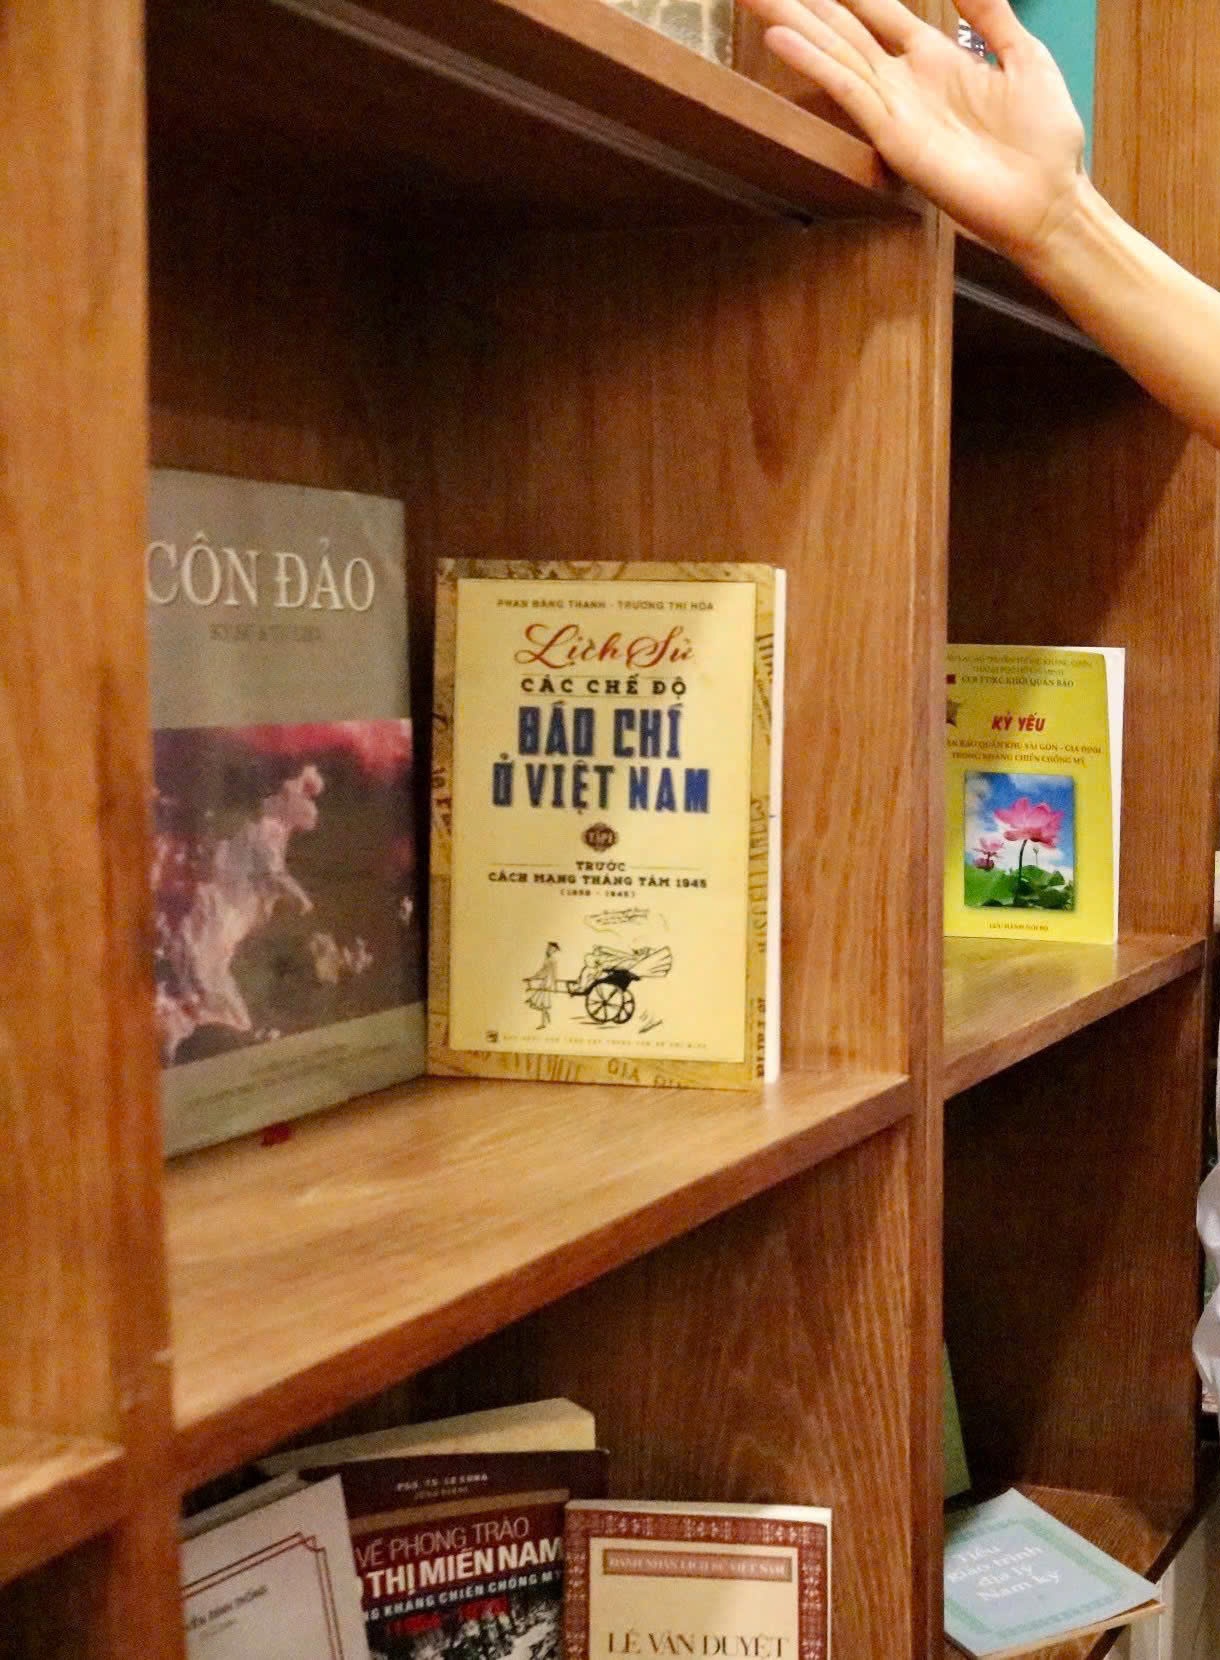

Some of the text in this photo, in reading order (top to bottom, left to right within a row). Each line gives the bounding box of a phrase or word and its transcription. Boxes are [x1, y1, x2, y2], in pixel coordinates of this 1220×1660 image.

[145, 530, 376, 613] CÔN ĐẢO
[496, 599, 529, 609] PHAN
[567, 600, 607, 610] THANH
[514, 622, 695, 670] Lịch Sử
[520, 673, 687, 700] CÁC CHẾ ĐỘ
[518, 700, 684, 759] BÁO CHÍ
[1018, 711, 1046, 732] YẾU
[492, 751, 515, 808] Ở
[525, 759, 615, 815] VIỆT
[628, 764, 711, 814] NAM
[488, 870, 528, 884] CÁCH
[533, 873, 577, 886] MẠNG
[582, 872, 633, 887] THÁNG
[638, 874, 670, 888] TÁM
[575, 859, 626, 872] TRƯỚC
[389, 1526, 468, 1563] PHONG
[472, 1513, 530, 1545] TRÀO
[366, 1536, 563, 1599] THỊ MIỀN NAM
[438, 1584, 484, 1606] CHIẾN
[648, 1629, 694, 1655] VĂN
[702, 1634, 789, 1659] DUYỆT
